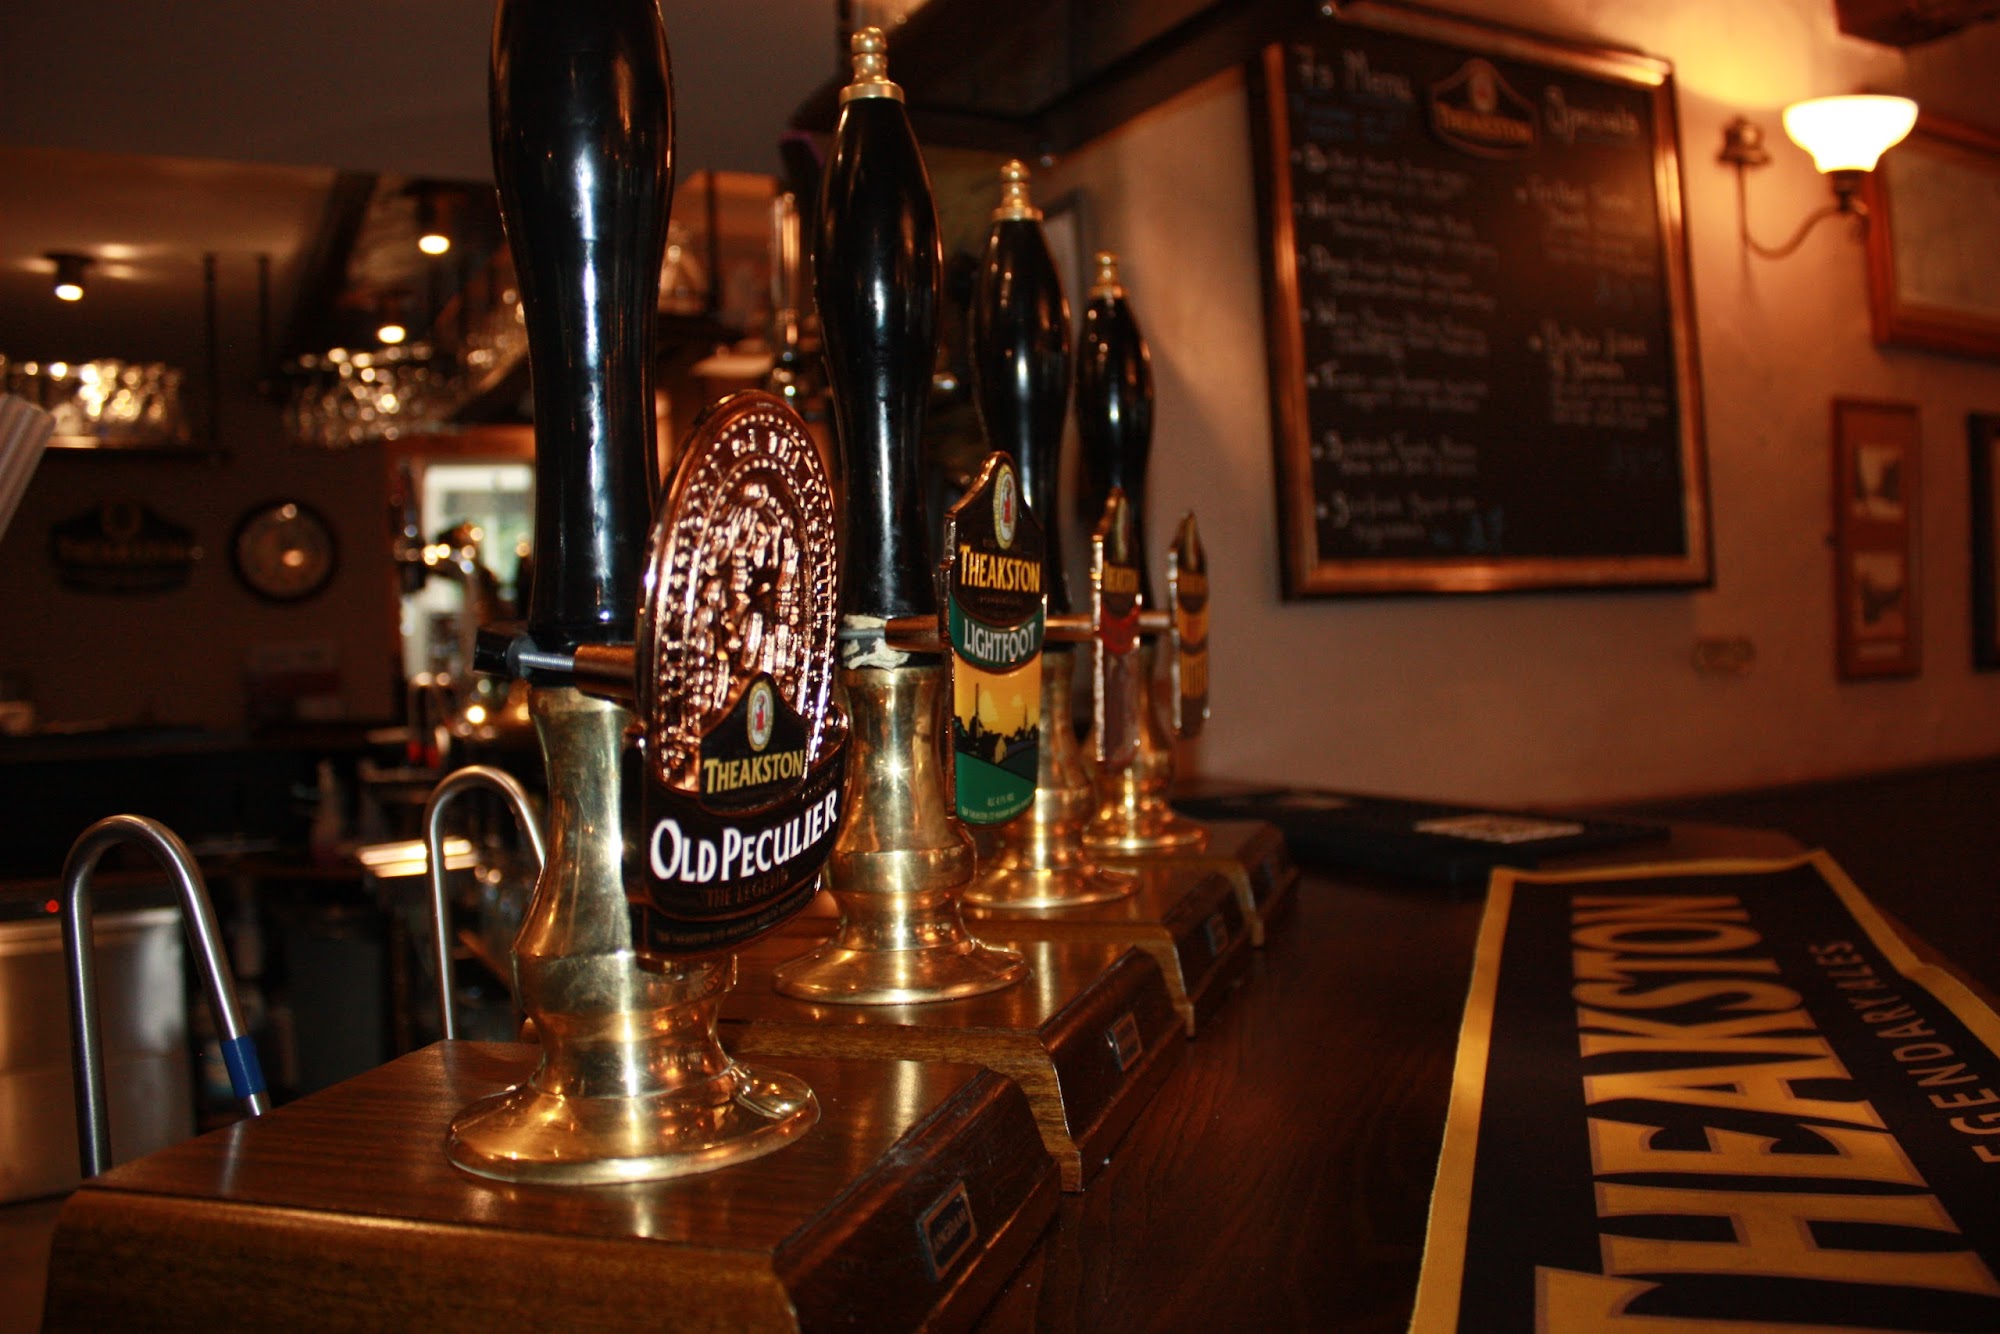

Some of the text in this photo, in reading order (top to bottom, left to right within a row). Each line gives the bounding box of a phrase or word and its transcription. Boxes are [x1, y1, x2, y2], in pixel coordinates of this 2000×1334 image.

[959, 543, 1041, 594] THEAKSTON
[963, 617, 1036, 663] LIGHTFOOT
[703, 749, 805, 795] THEAKSTON
[650, 788, 838, 884] OLD PECULIER
